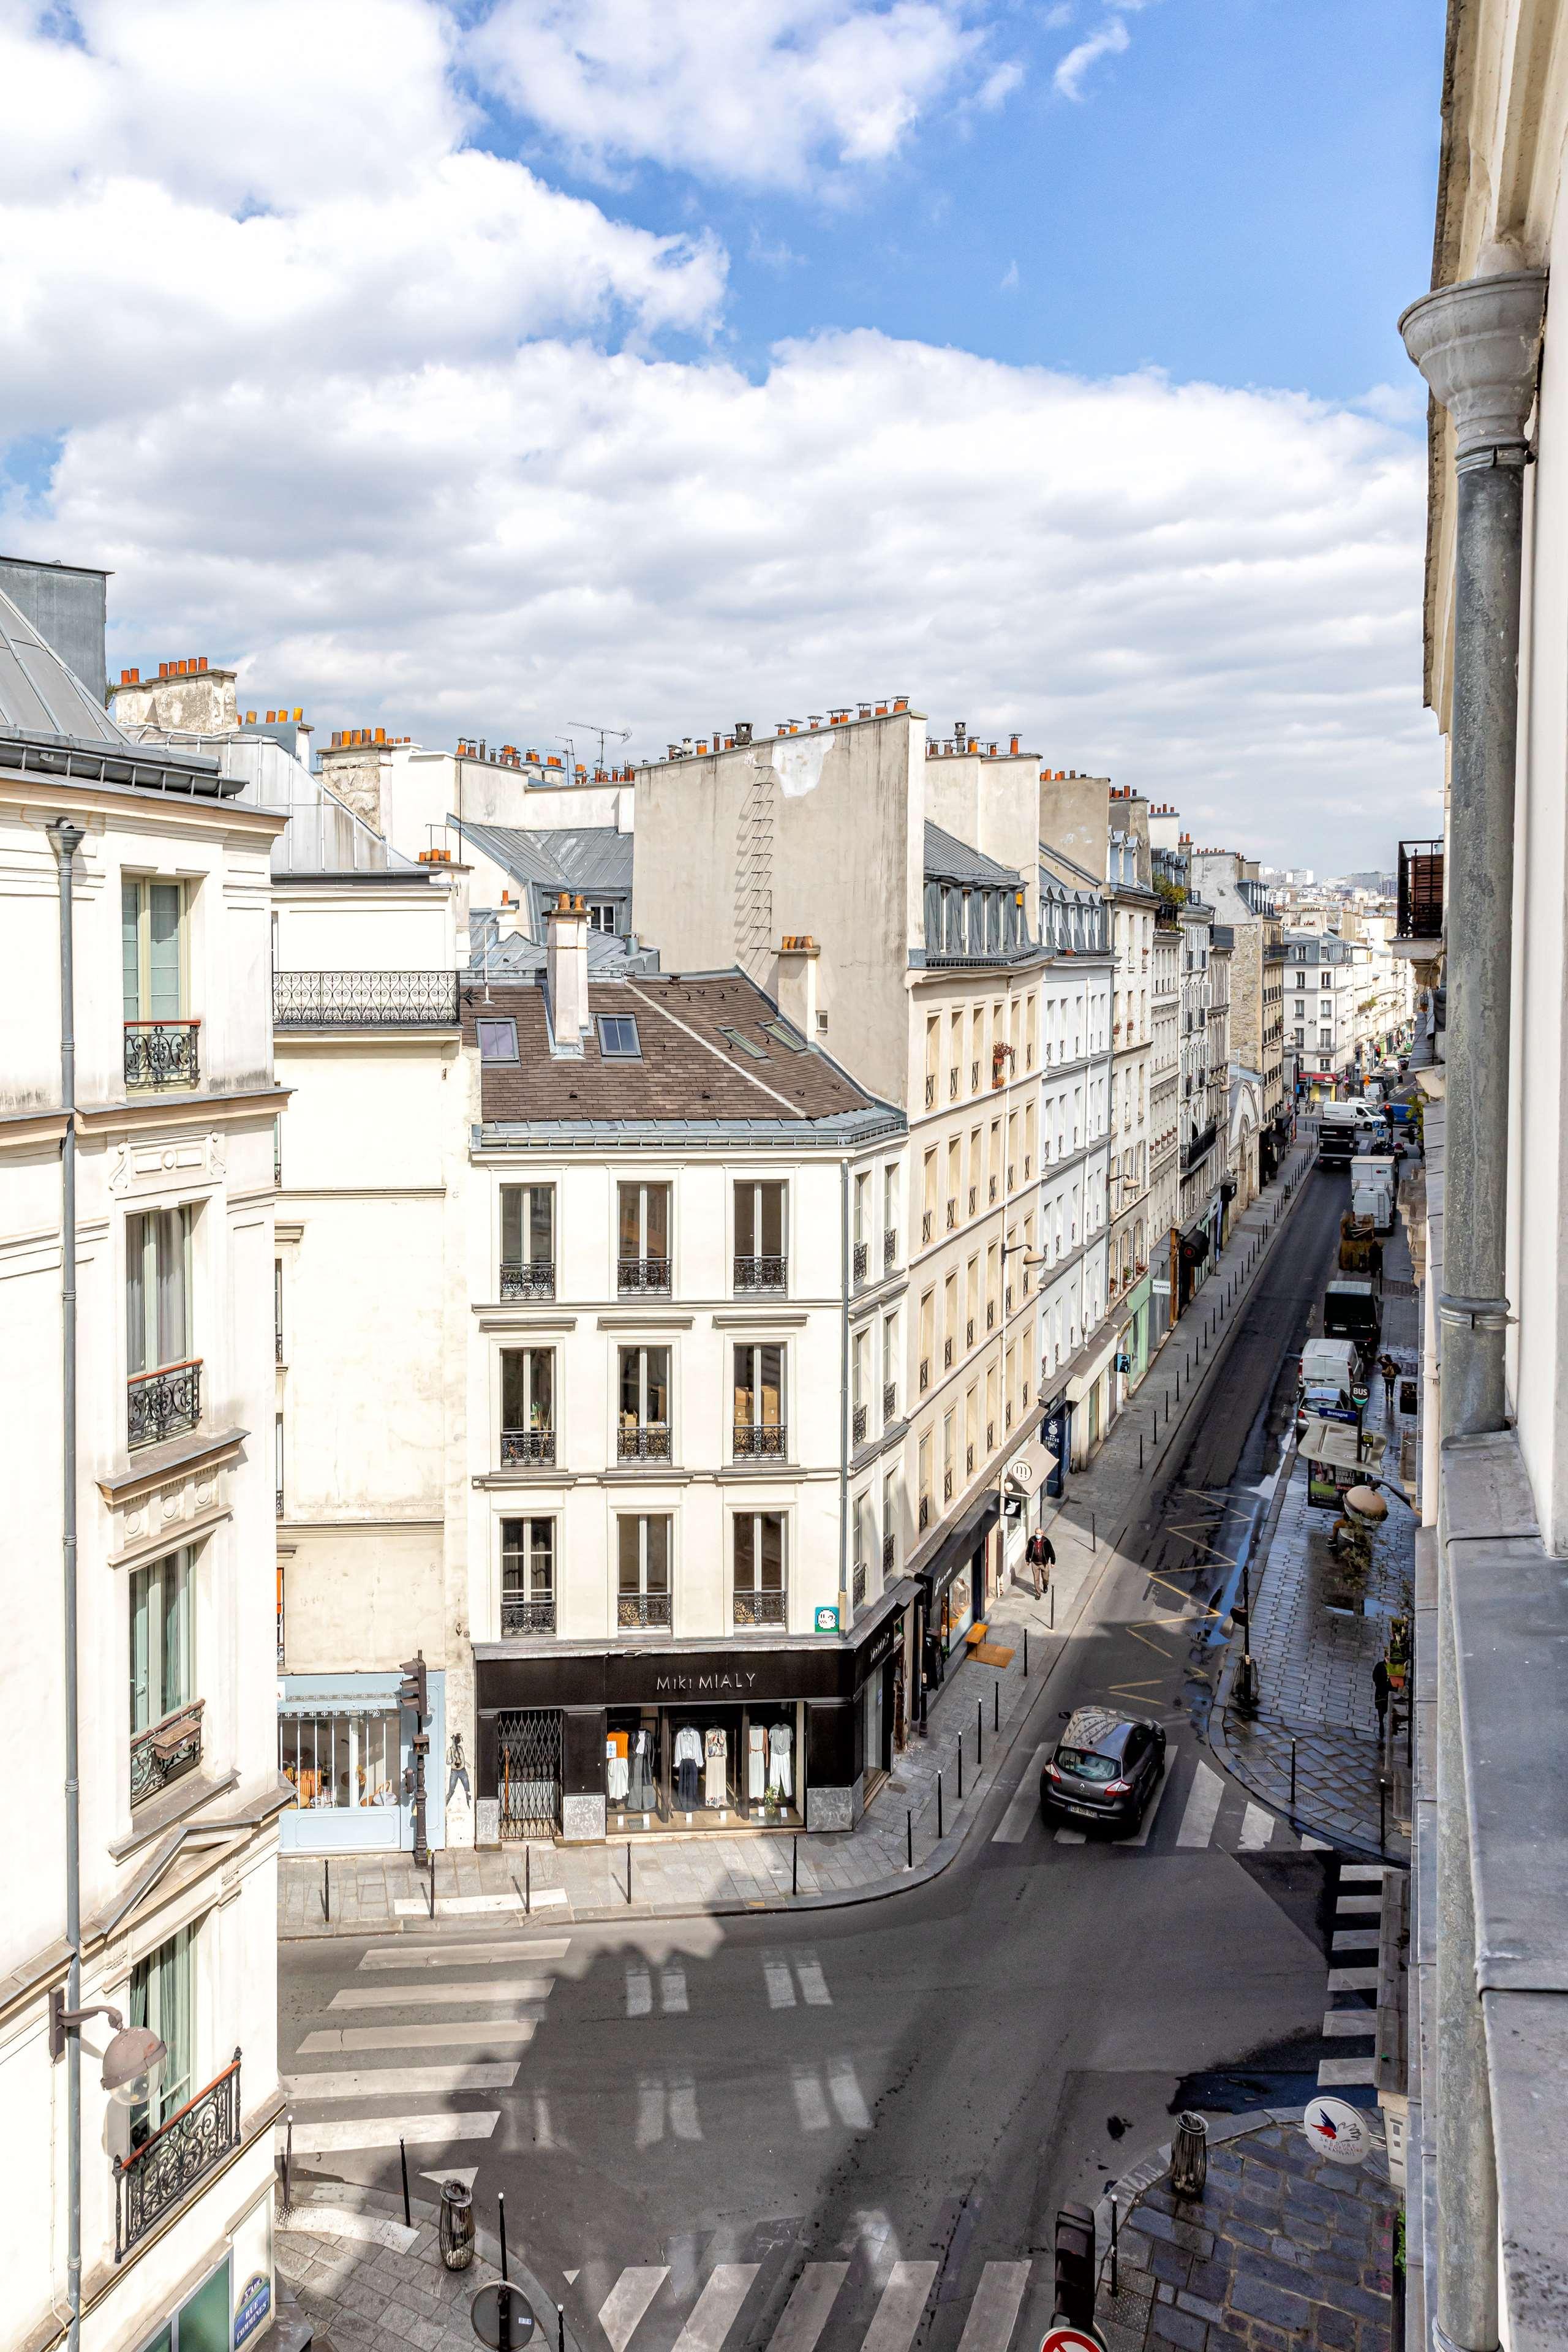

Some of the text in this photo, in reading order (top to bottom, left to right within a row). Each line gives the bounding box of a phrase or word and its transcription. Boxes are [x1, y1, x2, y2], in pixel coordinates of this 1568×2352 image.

[1353, 1387, 1368, 1396] BUS
[699, 1673, 756, 1689] MIALY
[244, 2299, 258, 2320] RUE
[236, 2301, 267, 2343] COMMINES
